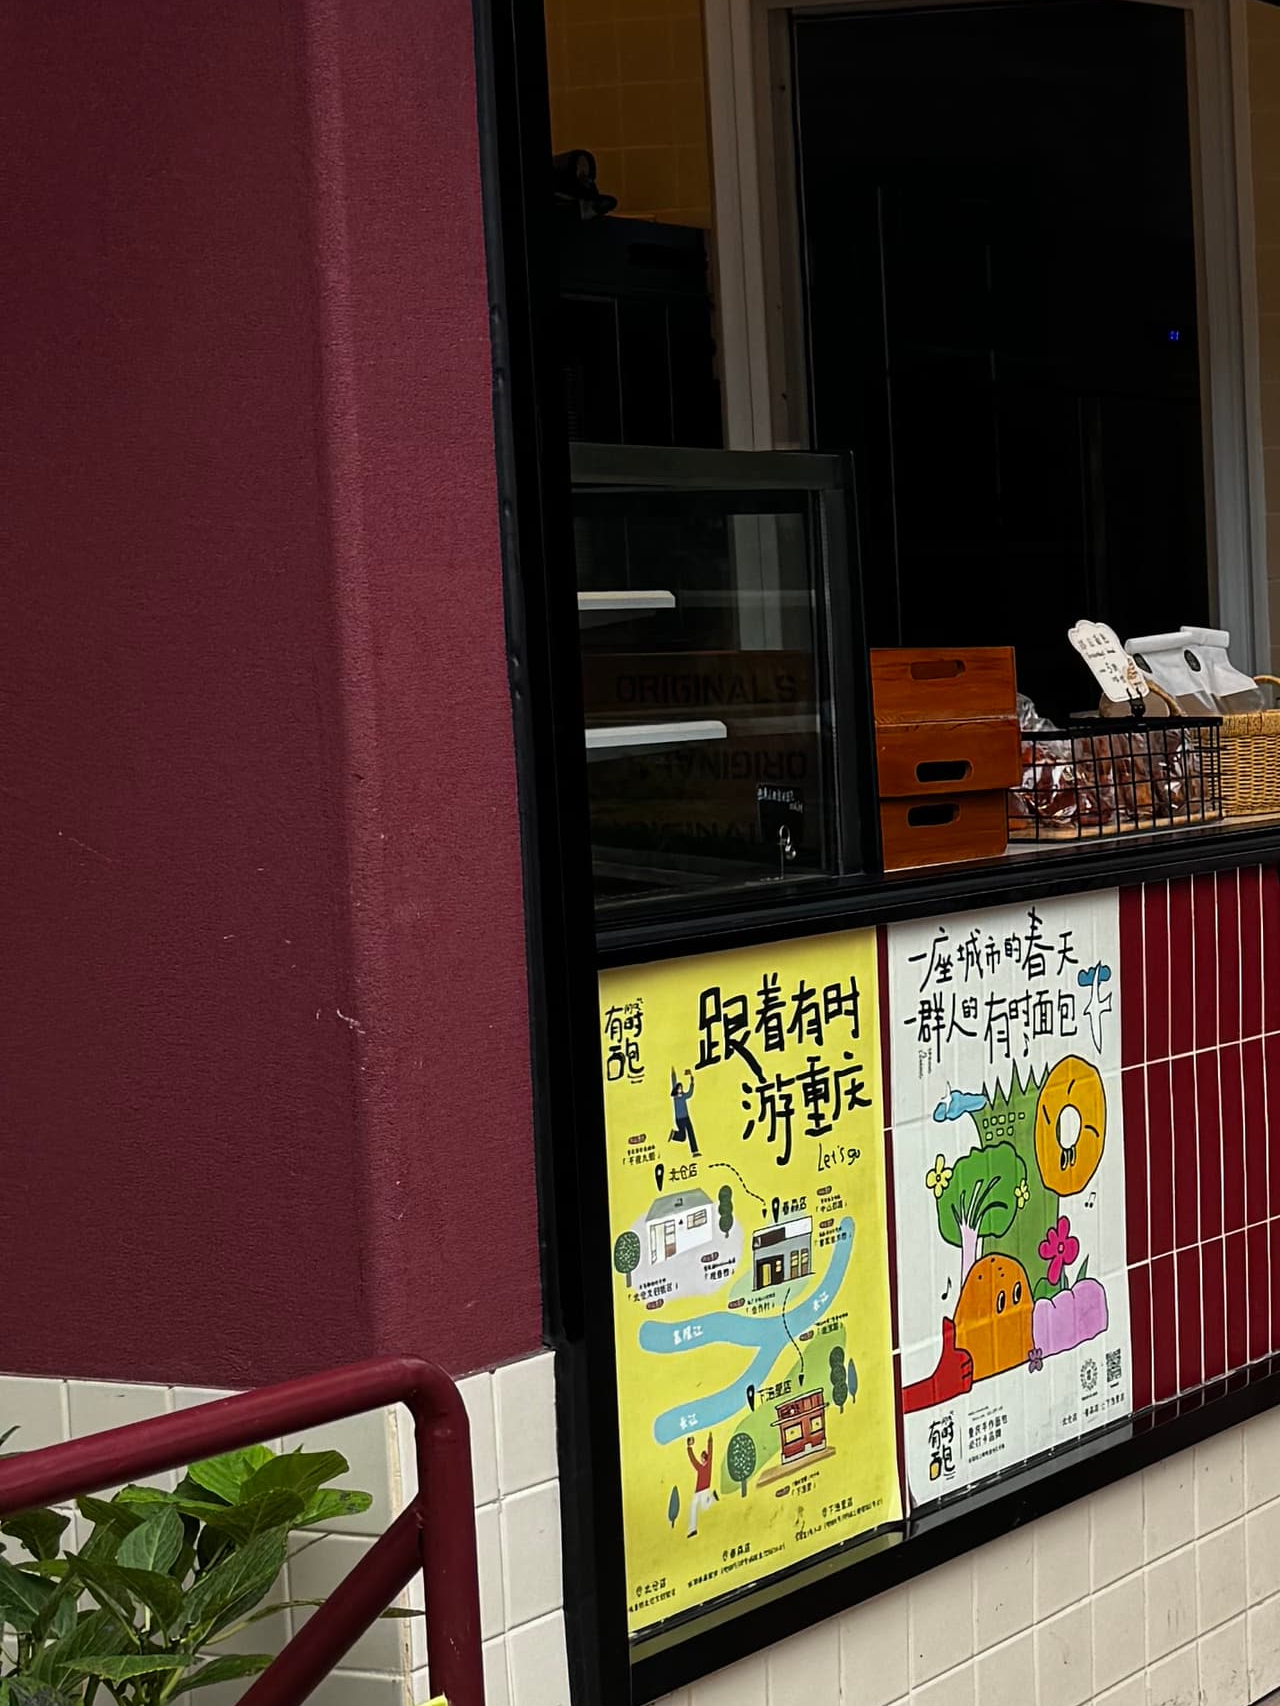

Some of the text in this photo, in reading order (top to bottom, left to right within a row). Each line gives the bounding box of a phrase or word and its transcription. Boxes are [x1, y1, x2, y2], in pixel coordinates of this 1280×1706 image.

[908, 906, 1079, 992] 一座城市的春天
[695, 972, 860, 1083] 跟着有时
[904, 988, 1078, 1064] 一群人的有时面包
[742, 1050, 873, 1167] 游重庆
[817, 1143, 845, 1172] Let's
